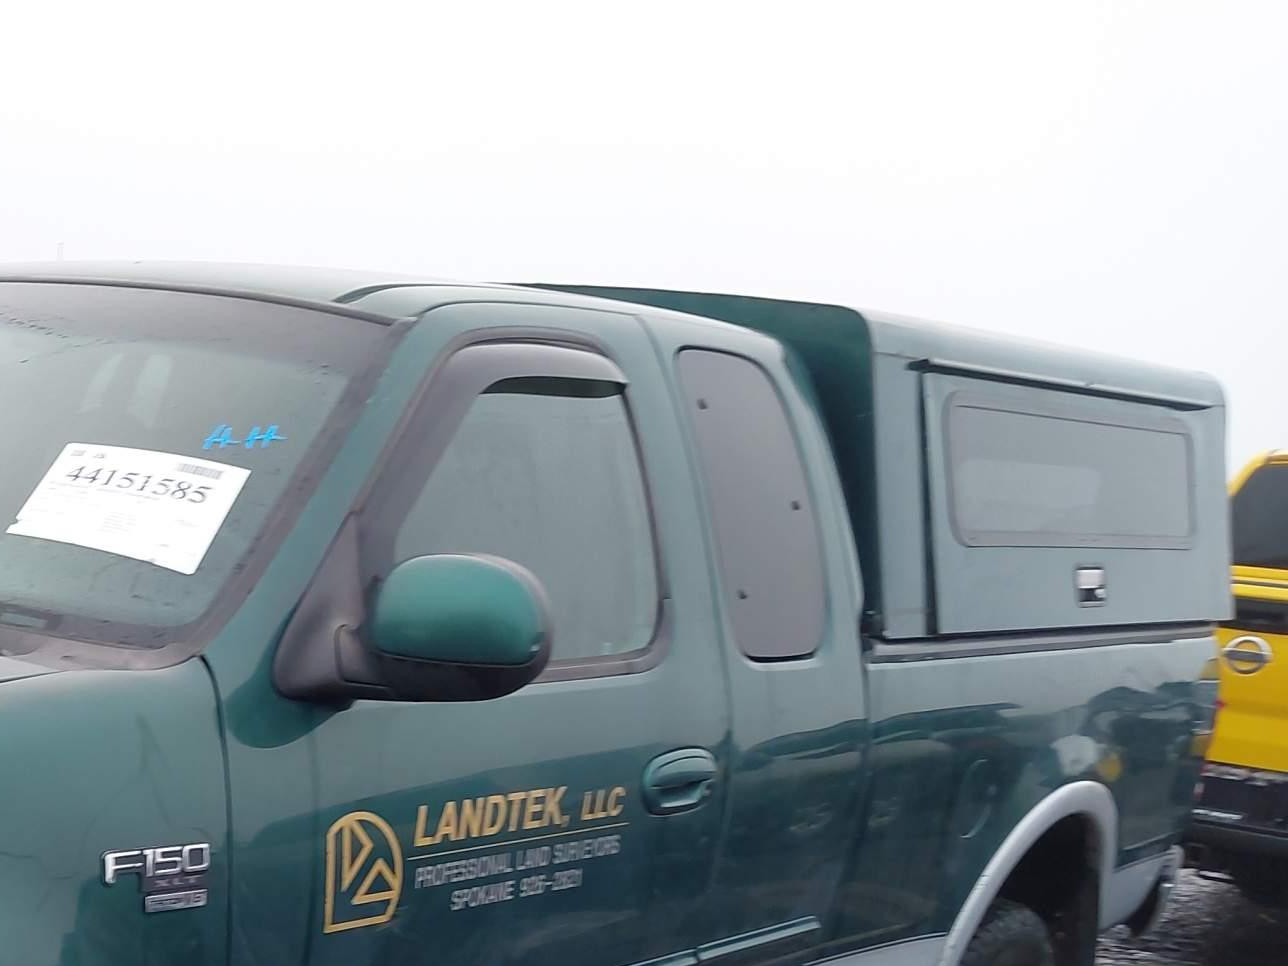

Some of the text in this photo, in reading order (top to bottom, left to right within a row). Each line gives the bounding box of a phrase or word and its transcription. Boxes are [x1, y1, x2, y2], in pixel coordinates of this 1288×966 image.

[66, 466, 213, 504] 44151585
[414, 786, 626, 847] LANDTEK, LLC
[104, 843, 211, 884] F150
[414, 835, 621, 889] PROFESSIONAL LAND SURVEYORS
[450, 880, 516, 911] SPOKANE
